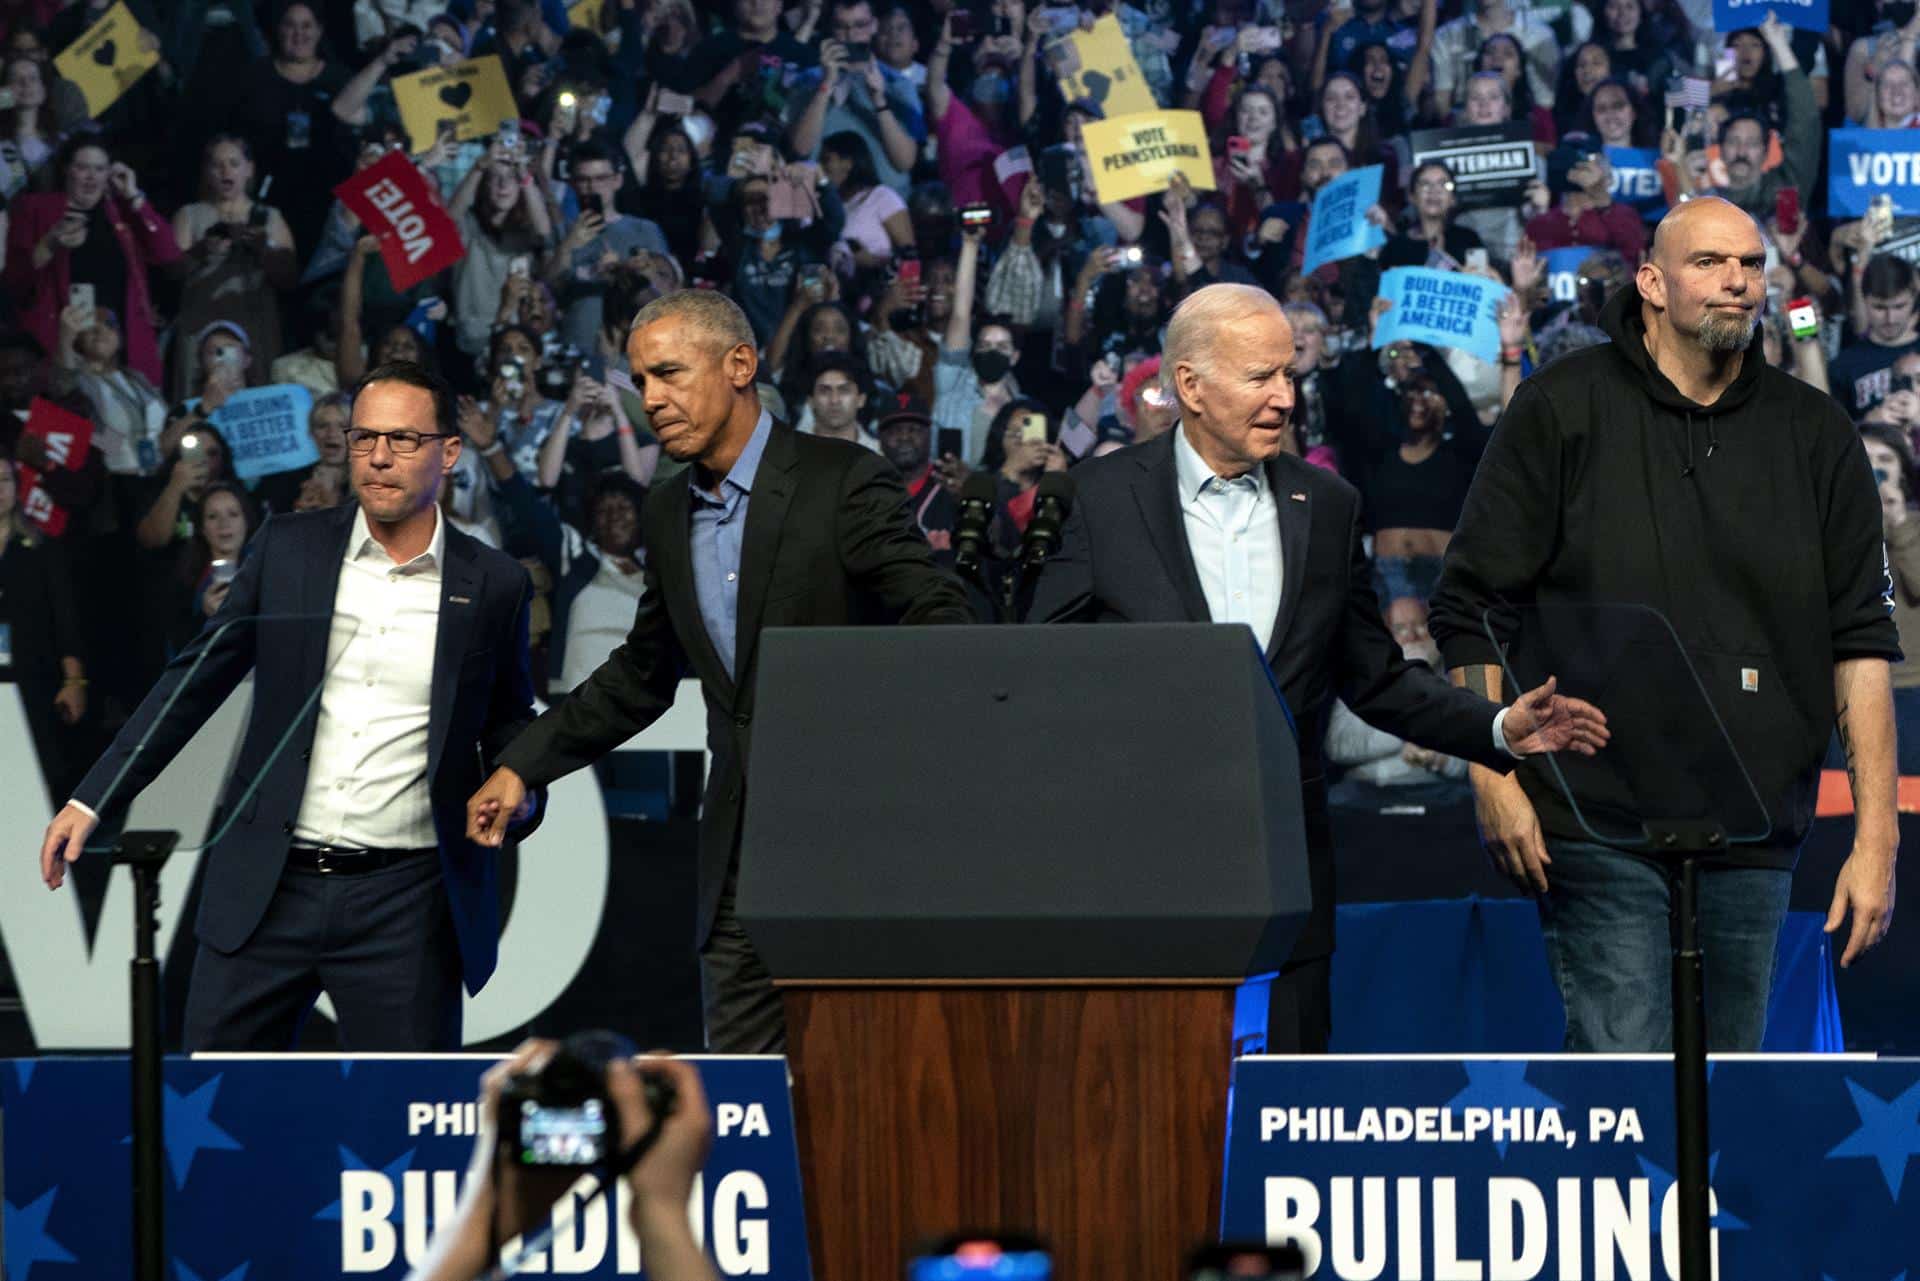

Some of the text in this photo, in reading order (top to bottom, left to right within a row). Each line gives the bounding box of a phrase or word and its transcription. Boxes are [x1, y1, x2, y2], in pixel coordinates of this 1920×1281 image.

[1132, 127, 1167, 146] VOTE
[364, 177, 434, 264] VOTE!
[1404, 276, 1483, 302] BUILDING
[1401, 293, 1413, 308] A
[1416, 293, 1478, 320] BETTER
[1400, 311, 1474, 336] AMERICA
[717, 1102, 771, 1137] PA
[1260, 1107, 1644, 1149] PHILADELPHIA, PA
